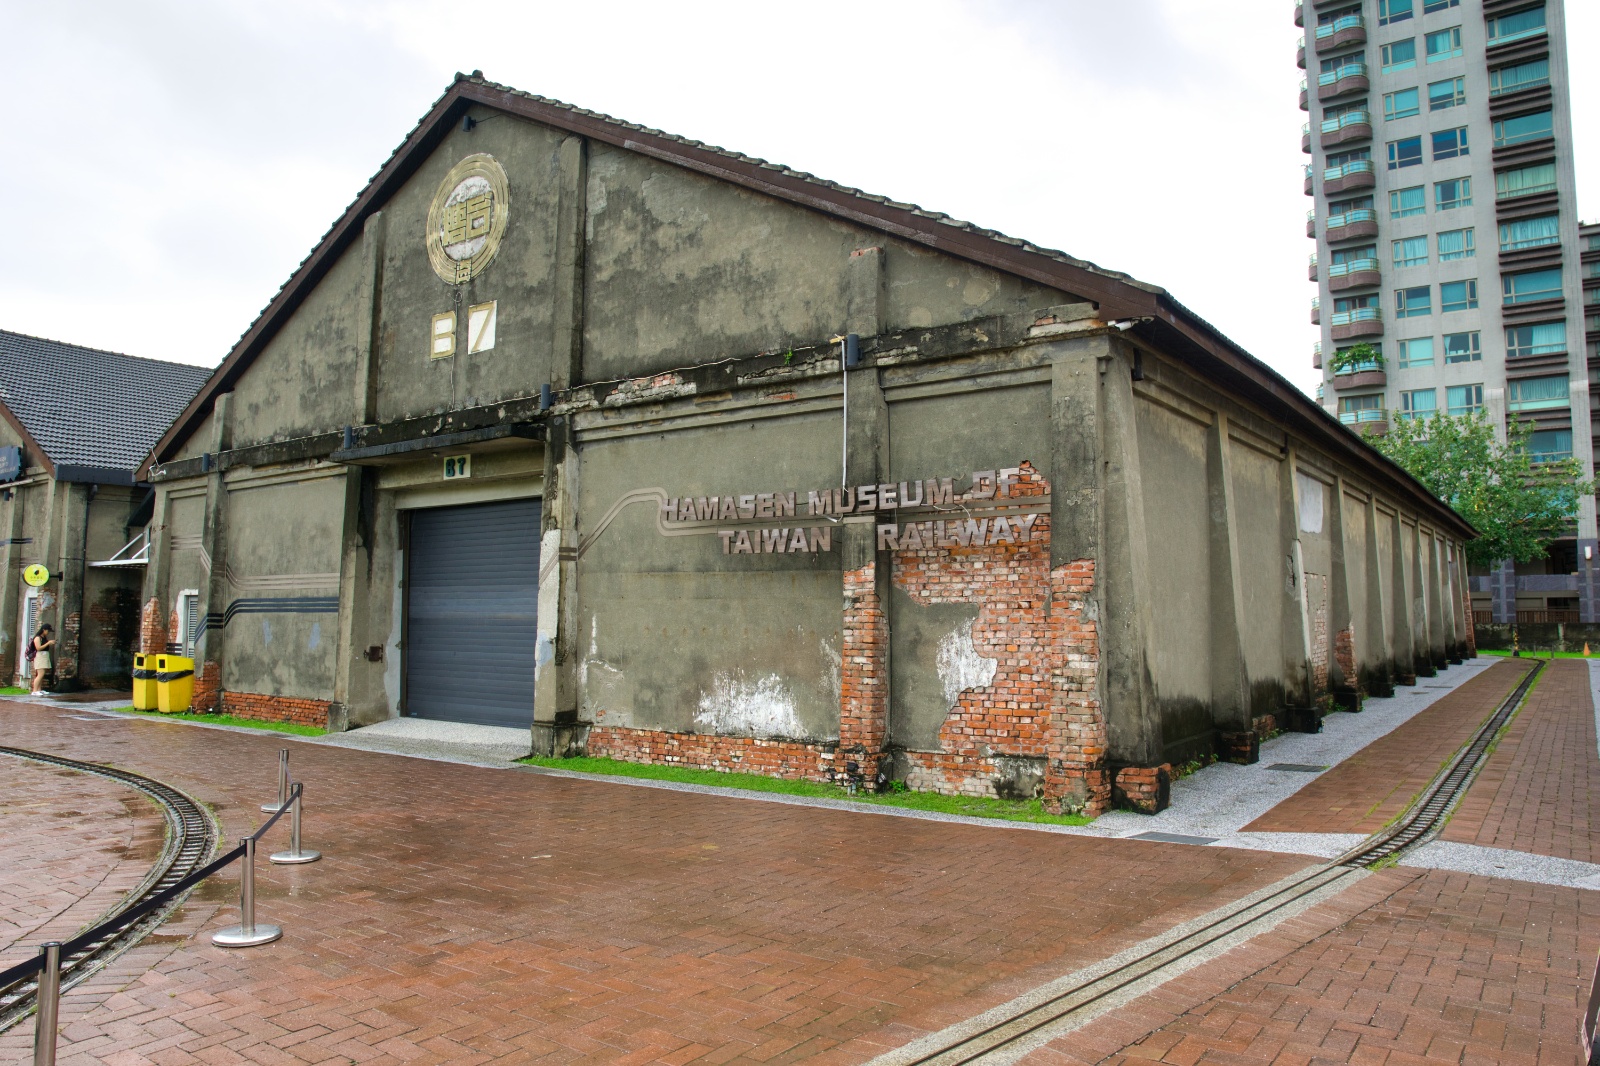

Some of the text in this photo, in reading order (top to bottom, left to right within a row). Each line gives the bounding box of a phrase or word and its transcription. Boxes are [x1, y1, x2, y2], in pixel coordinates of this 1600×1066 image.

[661, 467, 1021, 521] HAMASEN MUSEUM OF
[718, 514, 1039, 555] TAIWAN RAILWAY
